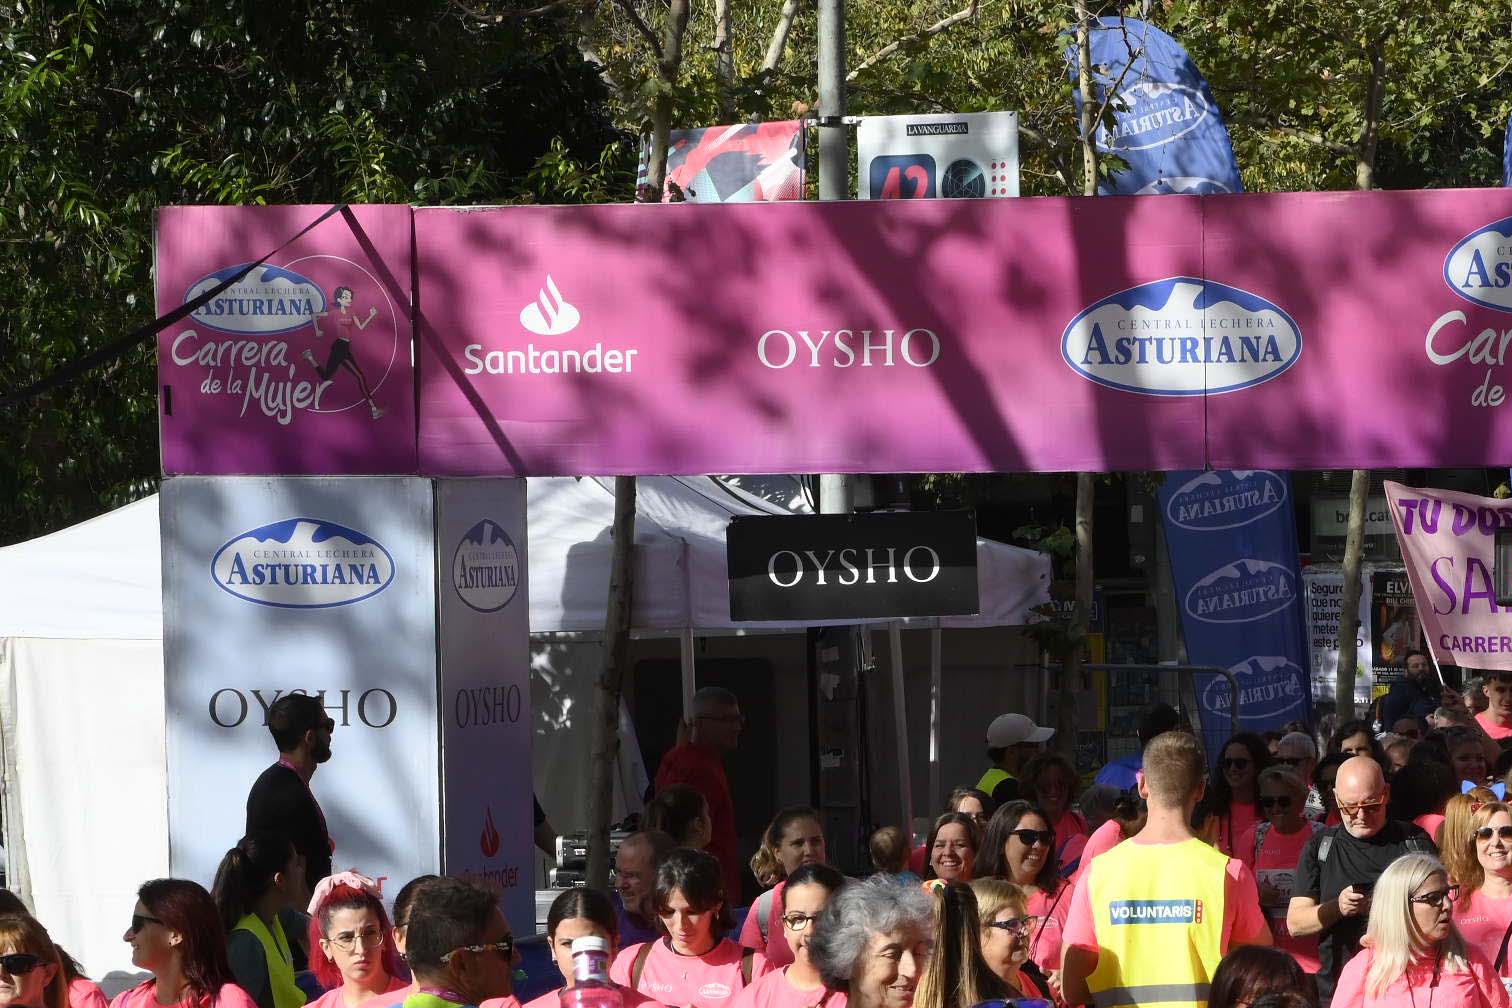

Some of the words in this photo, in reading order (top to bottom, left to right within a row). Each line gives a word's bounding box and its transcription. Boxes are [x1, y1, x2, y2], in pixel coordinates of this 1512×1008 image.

[918, 124, 968, 135] VANGUARDIA
[221, 287, 260, 295] ENTRAL
[1117, 319, 1192, 332] CENTRAL
[1200, 317, 1275, 329] LECHERA
[171, 329, 289, 367] Carrera
[464, 343, 639, 375] Santander
[757, 328, 940, 369] OYSHO
[1081, 322, 1282, 366] ASTURIANA
[200, 368, 222, 394] de
[226, 368, 243, 394] la
[239, 364, 335, 426] Mujer
[1471, 369, 1505, 407] de
[1398, 498, 1442, 536] TU
[225, 553, 382, 586] ASTURIANA
[253, 550, 311, 560] CENTRAL
[458, 555, 516, 589] ASTURIANA
[768, 546, 940, 588] OYSHO
[1312, 612, 1343, 624] quiere
[209, 688, 397, 728] OYHO
[455, 683, 521, 729] OYSHO
[1110, 906, 1193, 924] VOLUNTARIS
